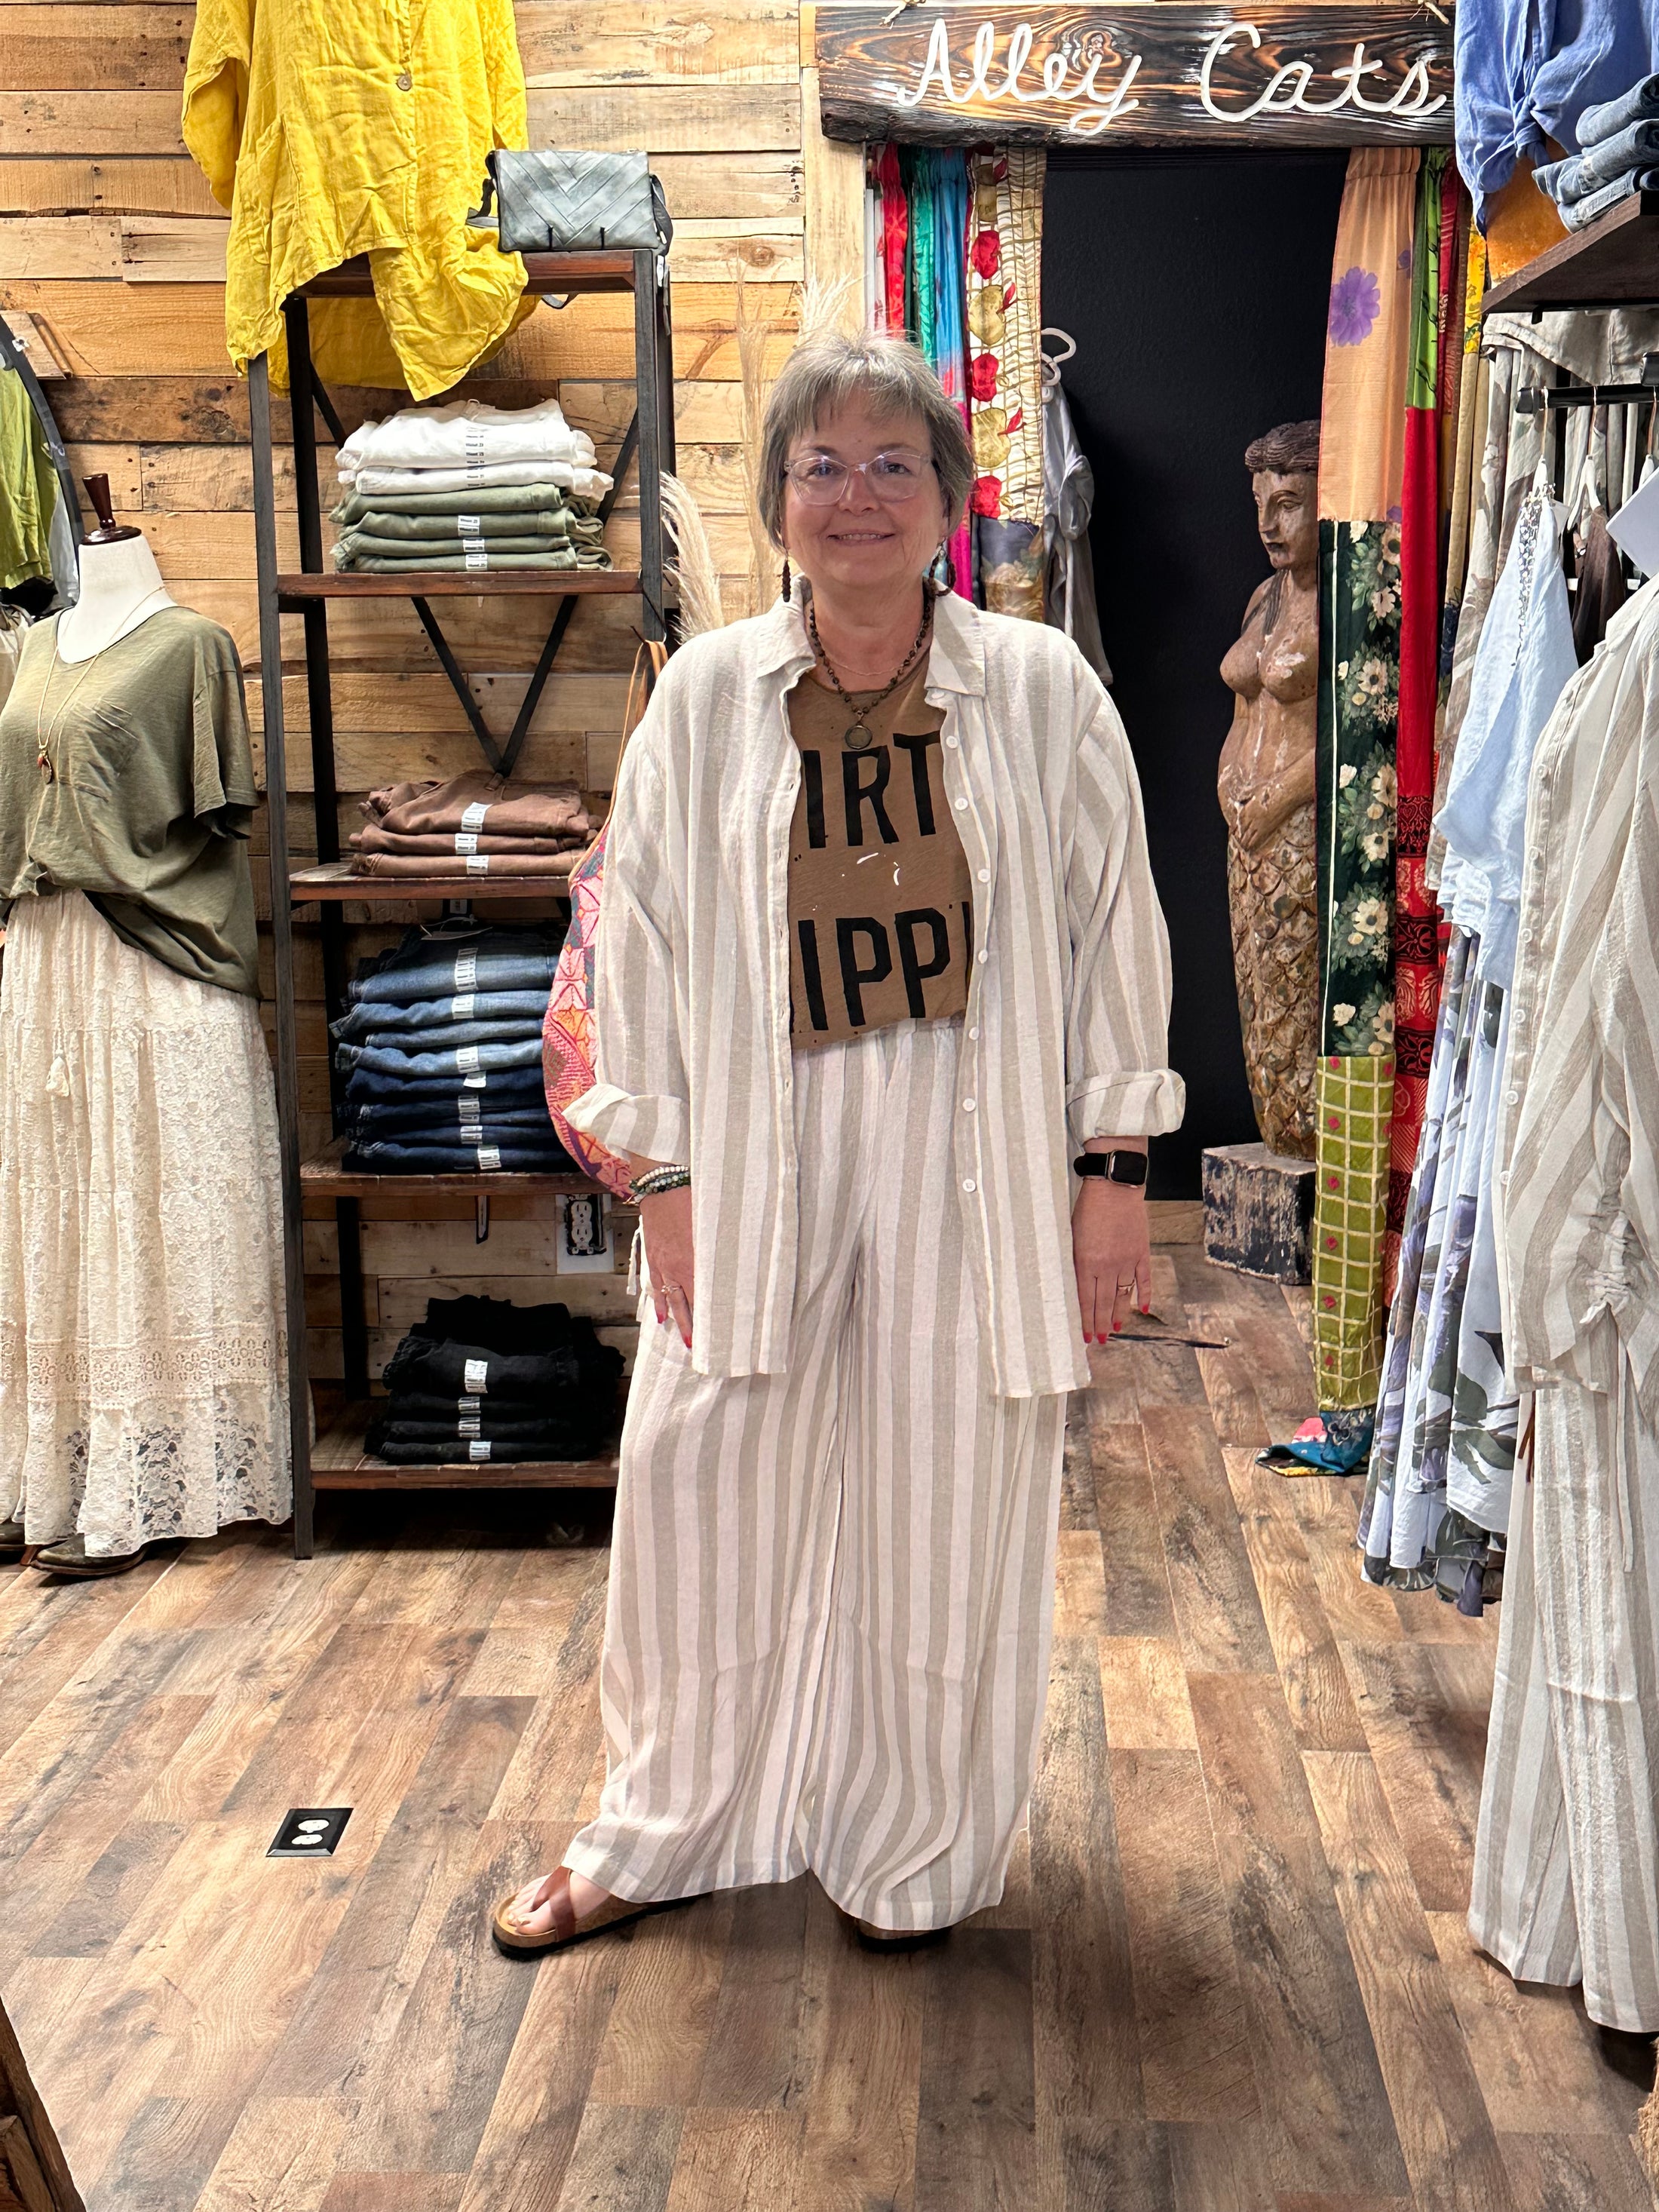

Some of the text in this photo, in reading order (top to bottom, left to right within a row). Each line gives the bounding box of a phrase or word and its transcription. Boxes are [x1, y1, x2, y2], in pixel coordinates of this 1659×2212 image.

[897, 17, 1447, 137] Alley Cats
[790, 901, 971, 1032] IPP
